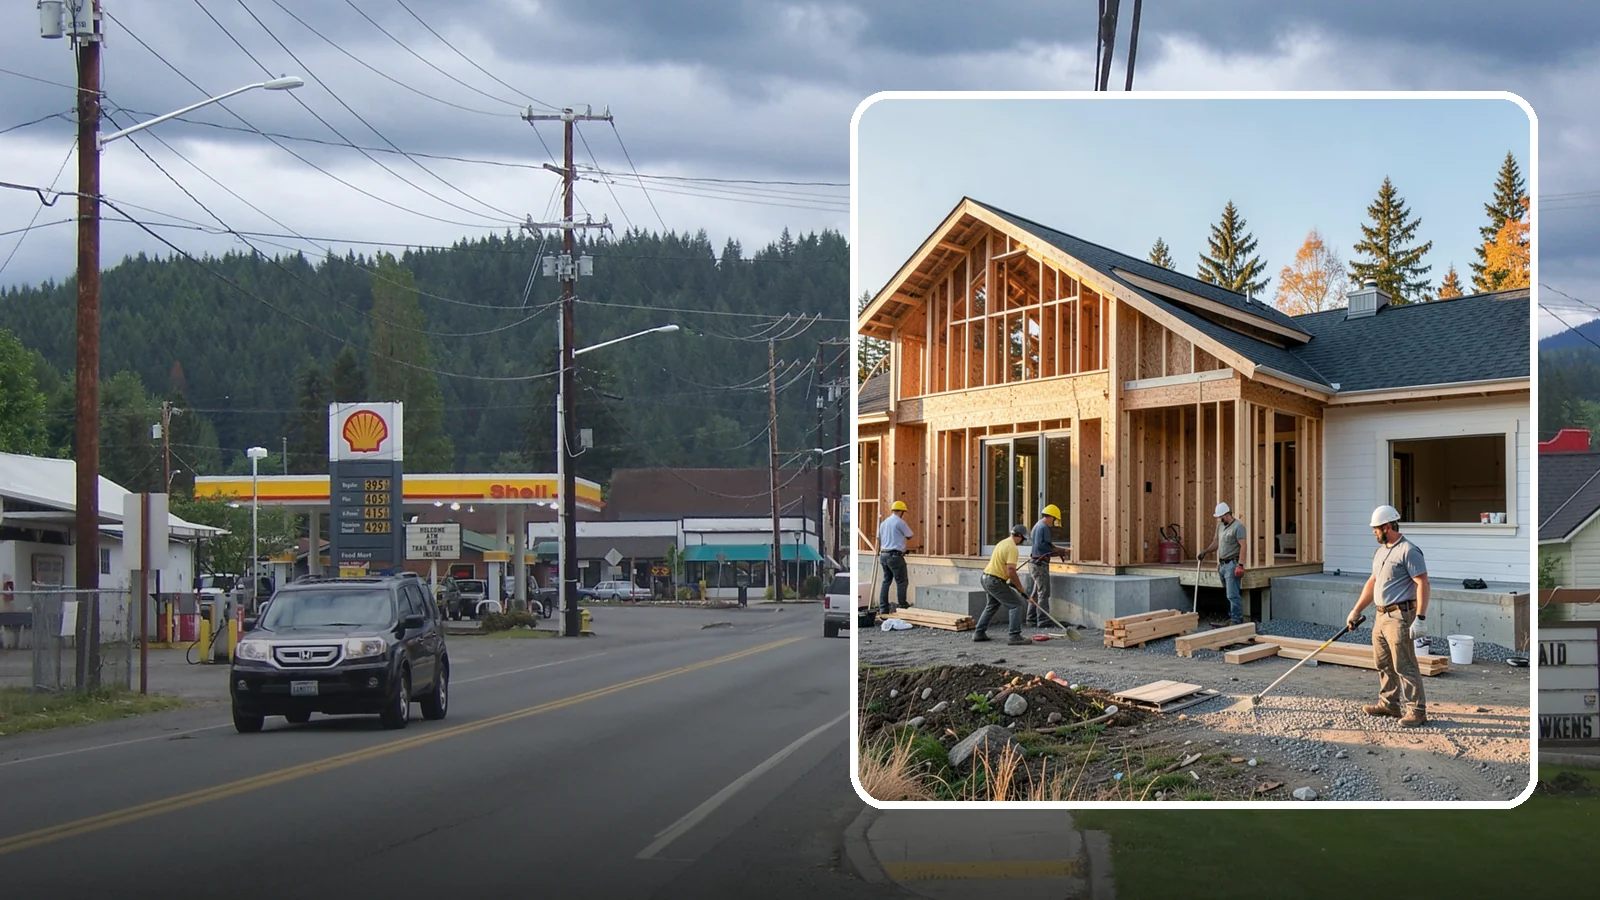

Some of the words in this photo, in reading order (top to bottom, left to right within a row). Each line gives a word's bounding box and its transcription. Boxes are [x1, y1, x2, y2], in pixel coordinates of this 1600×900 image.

[366, 480, 383, 490] 395
[490, 484, 547, 499] Shell
[366, 494, 383, 504] 405
[366, 508, 383, 518] 415
[366, 522, 383, 532] 429
